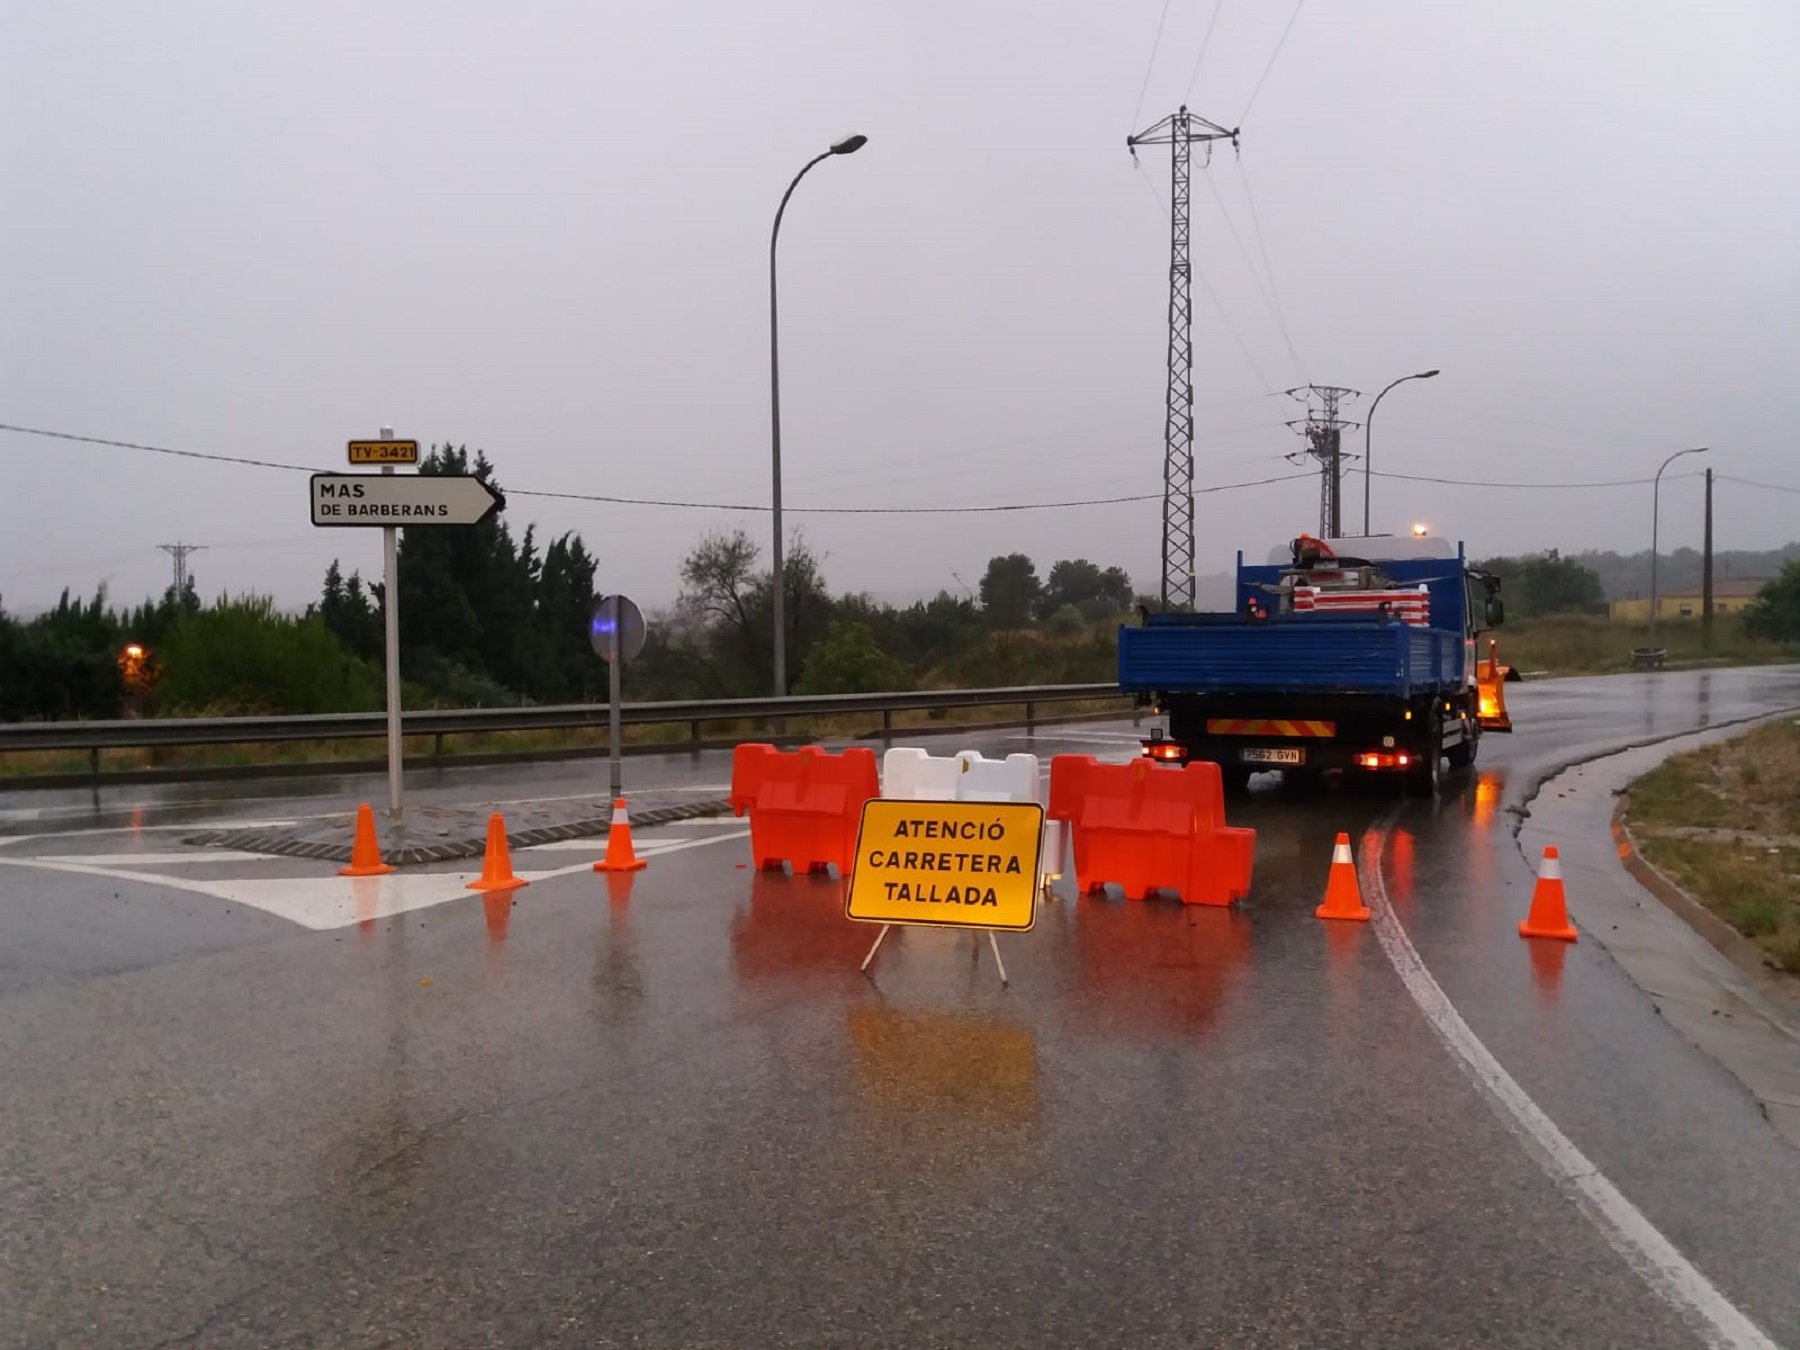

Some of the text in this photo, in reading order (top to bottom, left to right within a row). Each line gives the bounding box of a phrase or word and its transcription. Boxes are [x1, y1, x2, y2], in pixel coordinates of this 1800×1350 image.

[353, 447, 414, 458] TV-3421
[320, 484, 365, 498] MAS
[321, 504, 448, 516] DE BARBERANS
[1277, 751, 1297, 760] GVN
[894, 818, 1005, 841] ATENCIÓ
[869, 851, 1021, 874] CARRETERA
[884, 882, 998, 907] TALLADA
